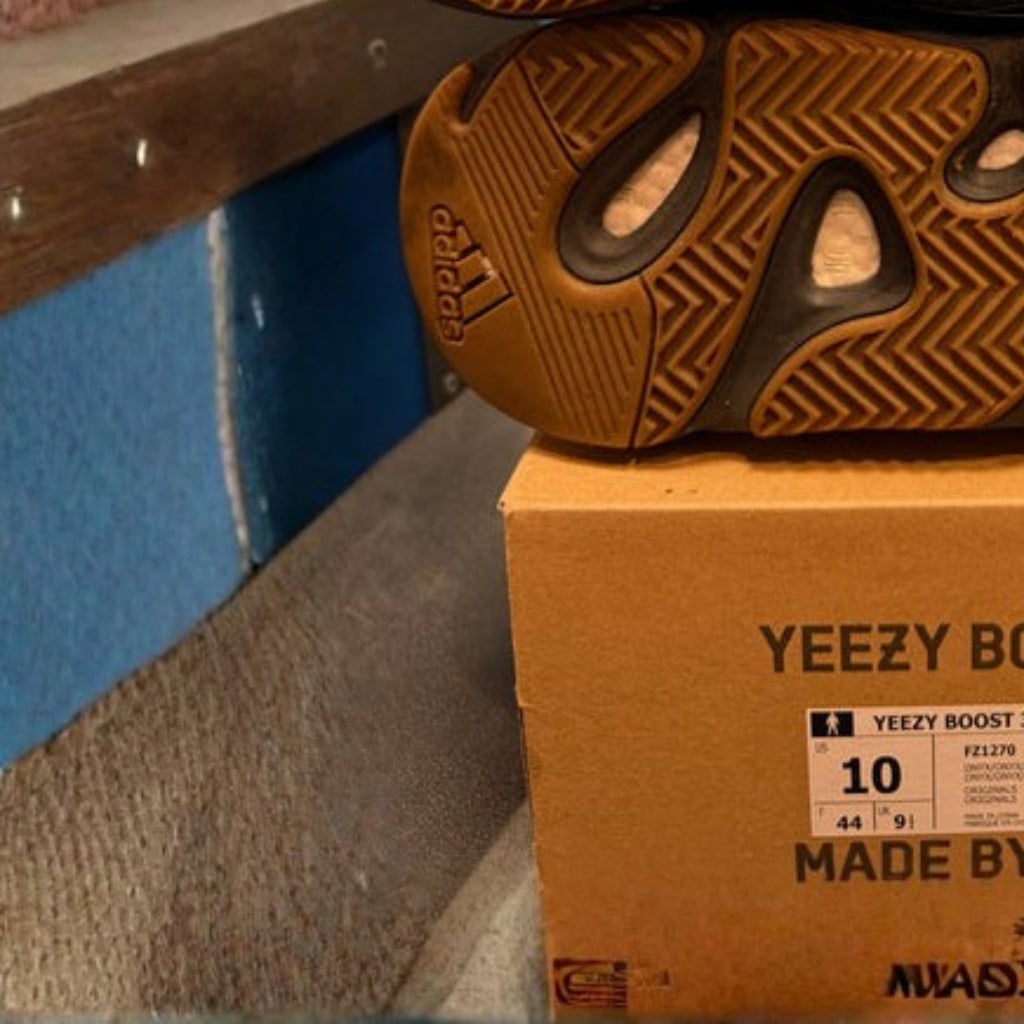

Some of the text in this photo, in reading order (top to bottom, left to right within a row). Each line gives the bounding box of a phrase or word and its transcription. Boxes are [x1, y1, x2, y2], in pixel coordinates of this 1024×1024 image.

[760, 621, 951, 674] YEEZY
[873, 713, 937, 731] YEEZY
[945, 711, 1014, 730] BOOST
[964, 743, 1016, 758] FZ1270
[842, 755, 902, 795] 10
[836, 815, 863, 831] 44
[794, 839, 952, 884] MADE
